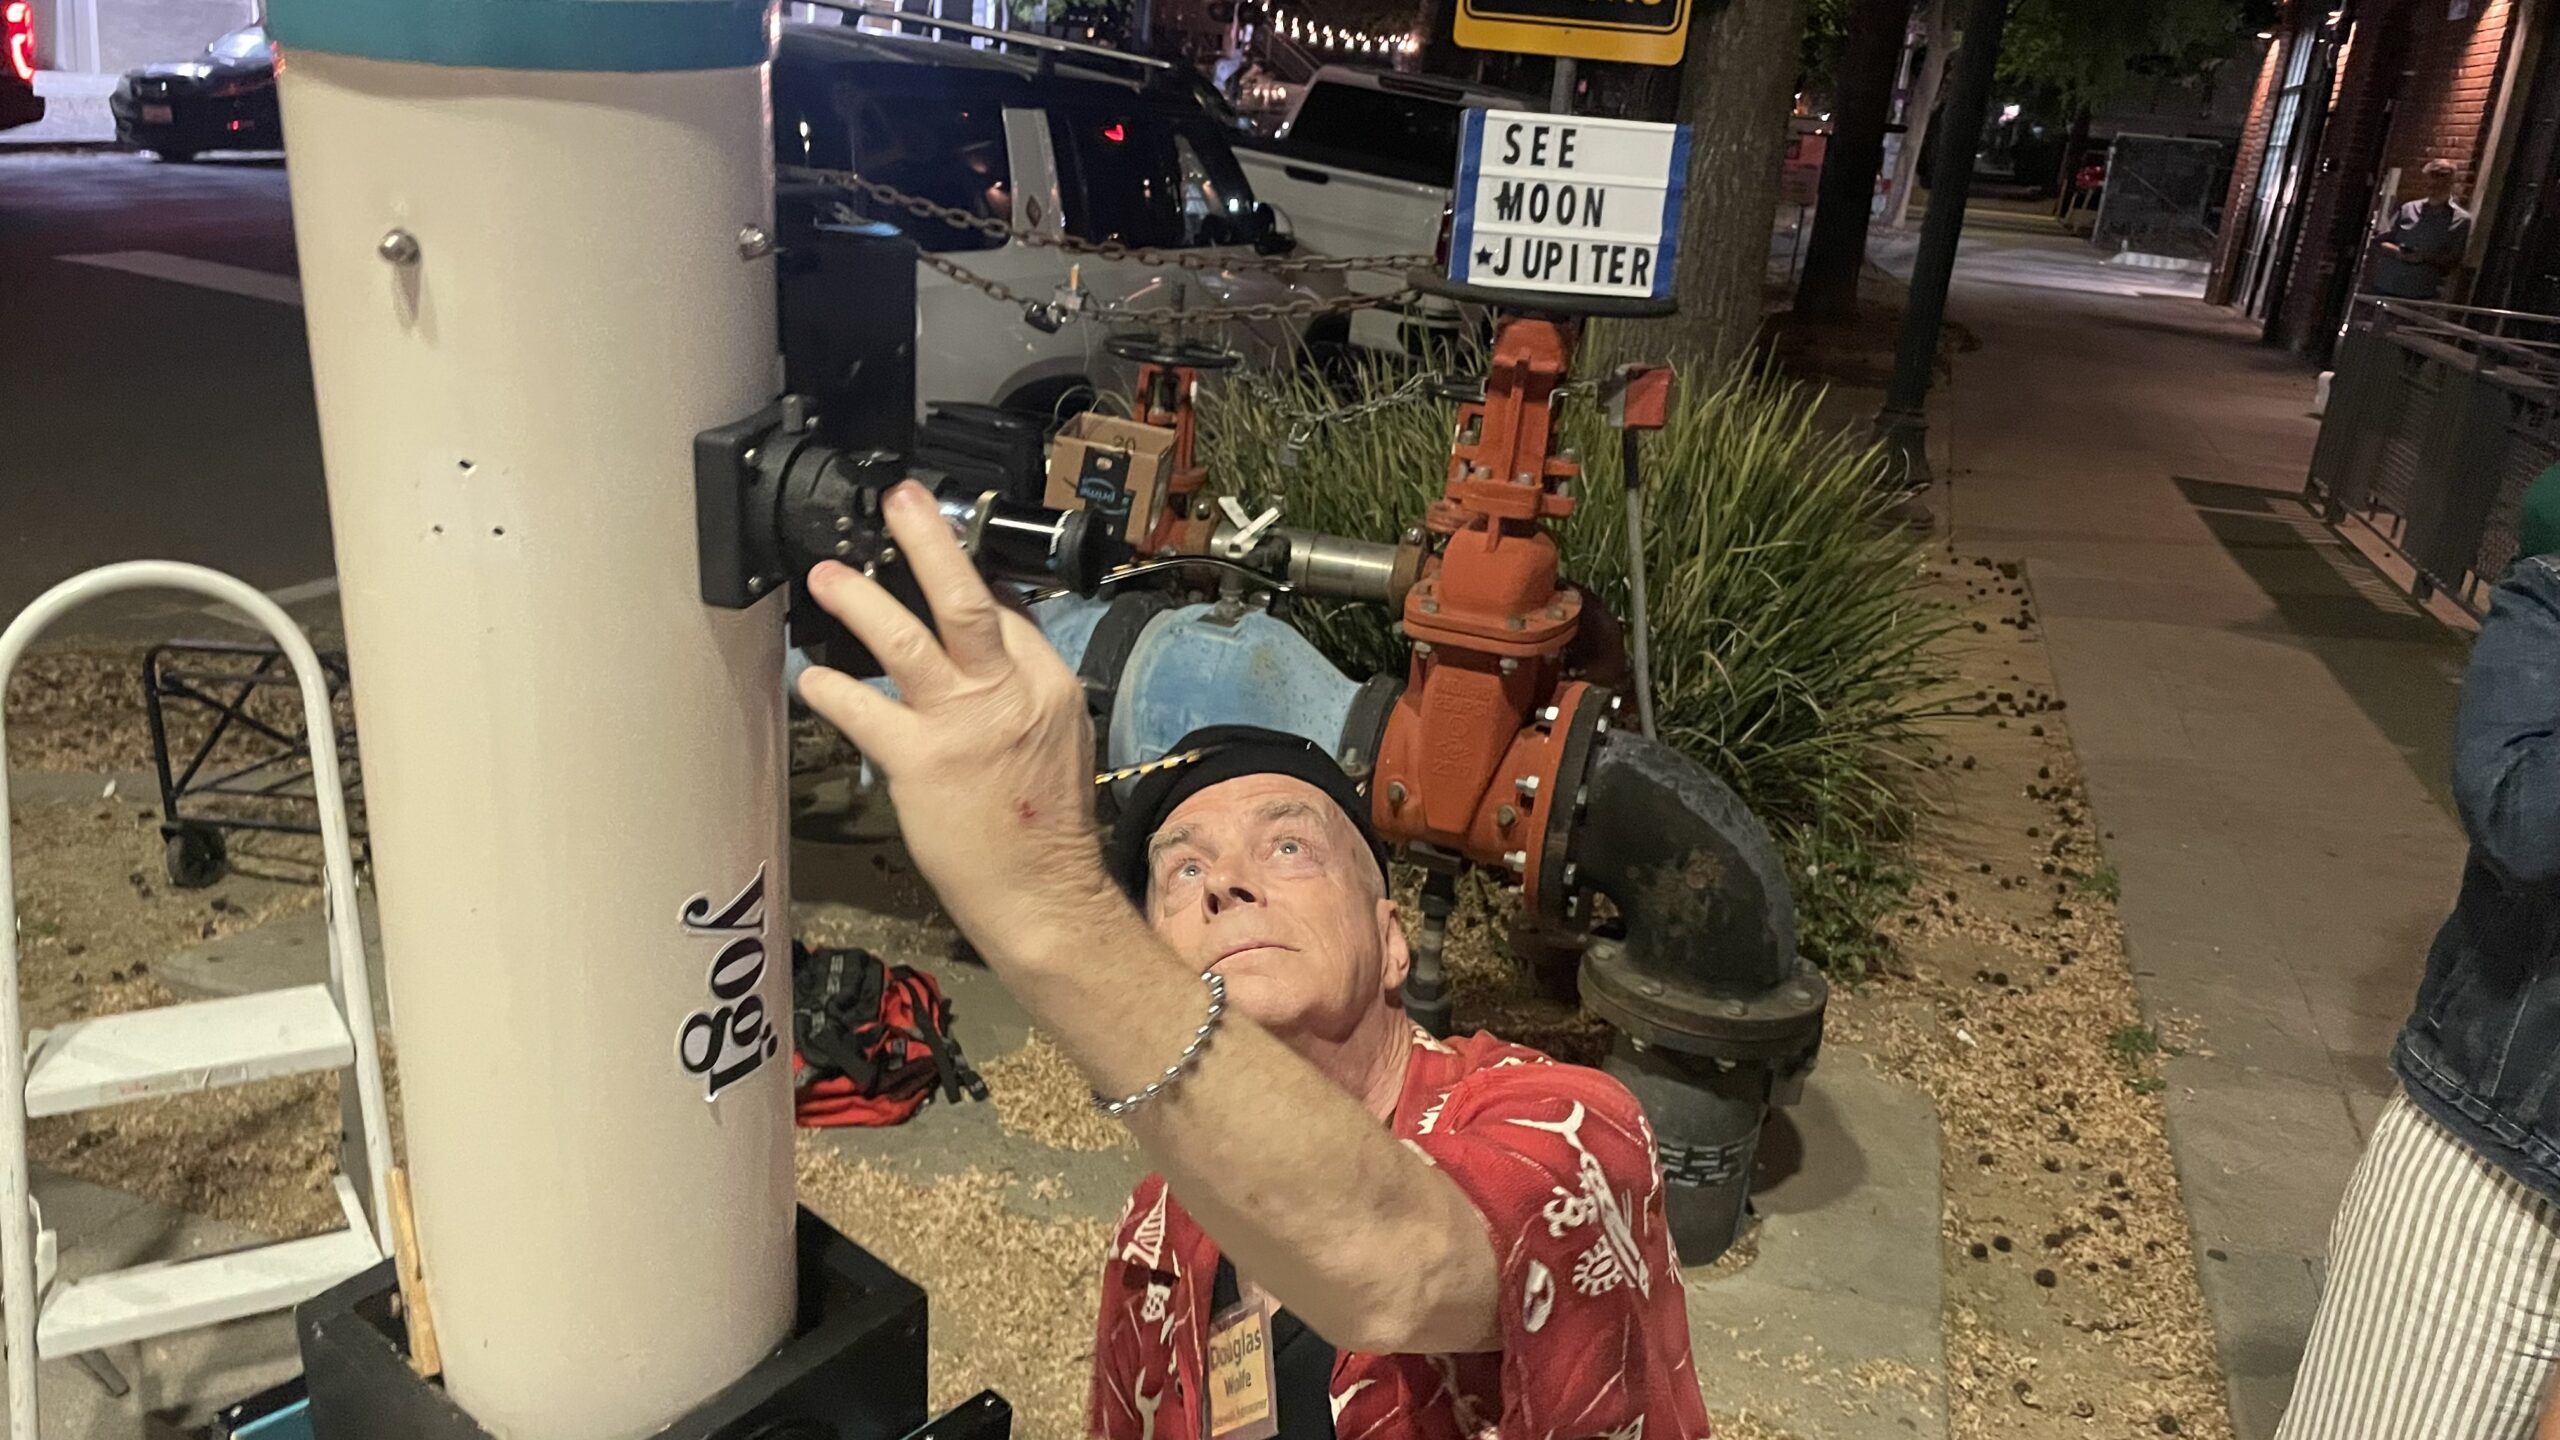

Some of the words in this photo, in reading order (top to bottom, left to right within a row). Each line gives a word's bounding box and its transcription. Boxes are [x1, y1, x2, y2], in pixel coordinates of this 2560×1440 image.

[1502, 122, 1577, 169] SEE
[1498, 180, 1606, 228] MOON
[1493, 237, 1651, 287] JUPITER
[1209, 1328, 1262, 1372] Douglas
